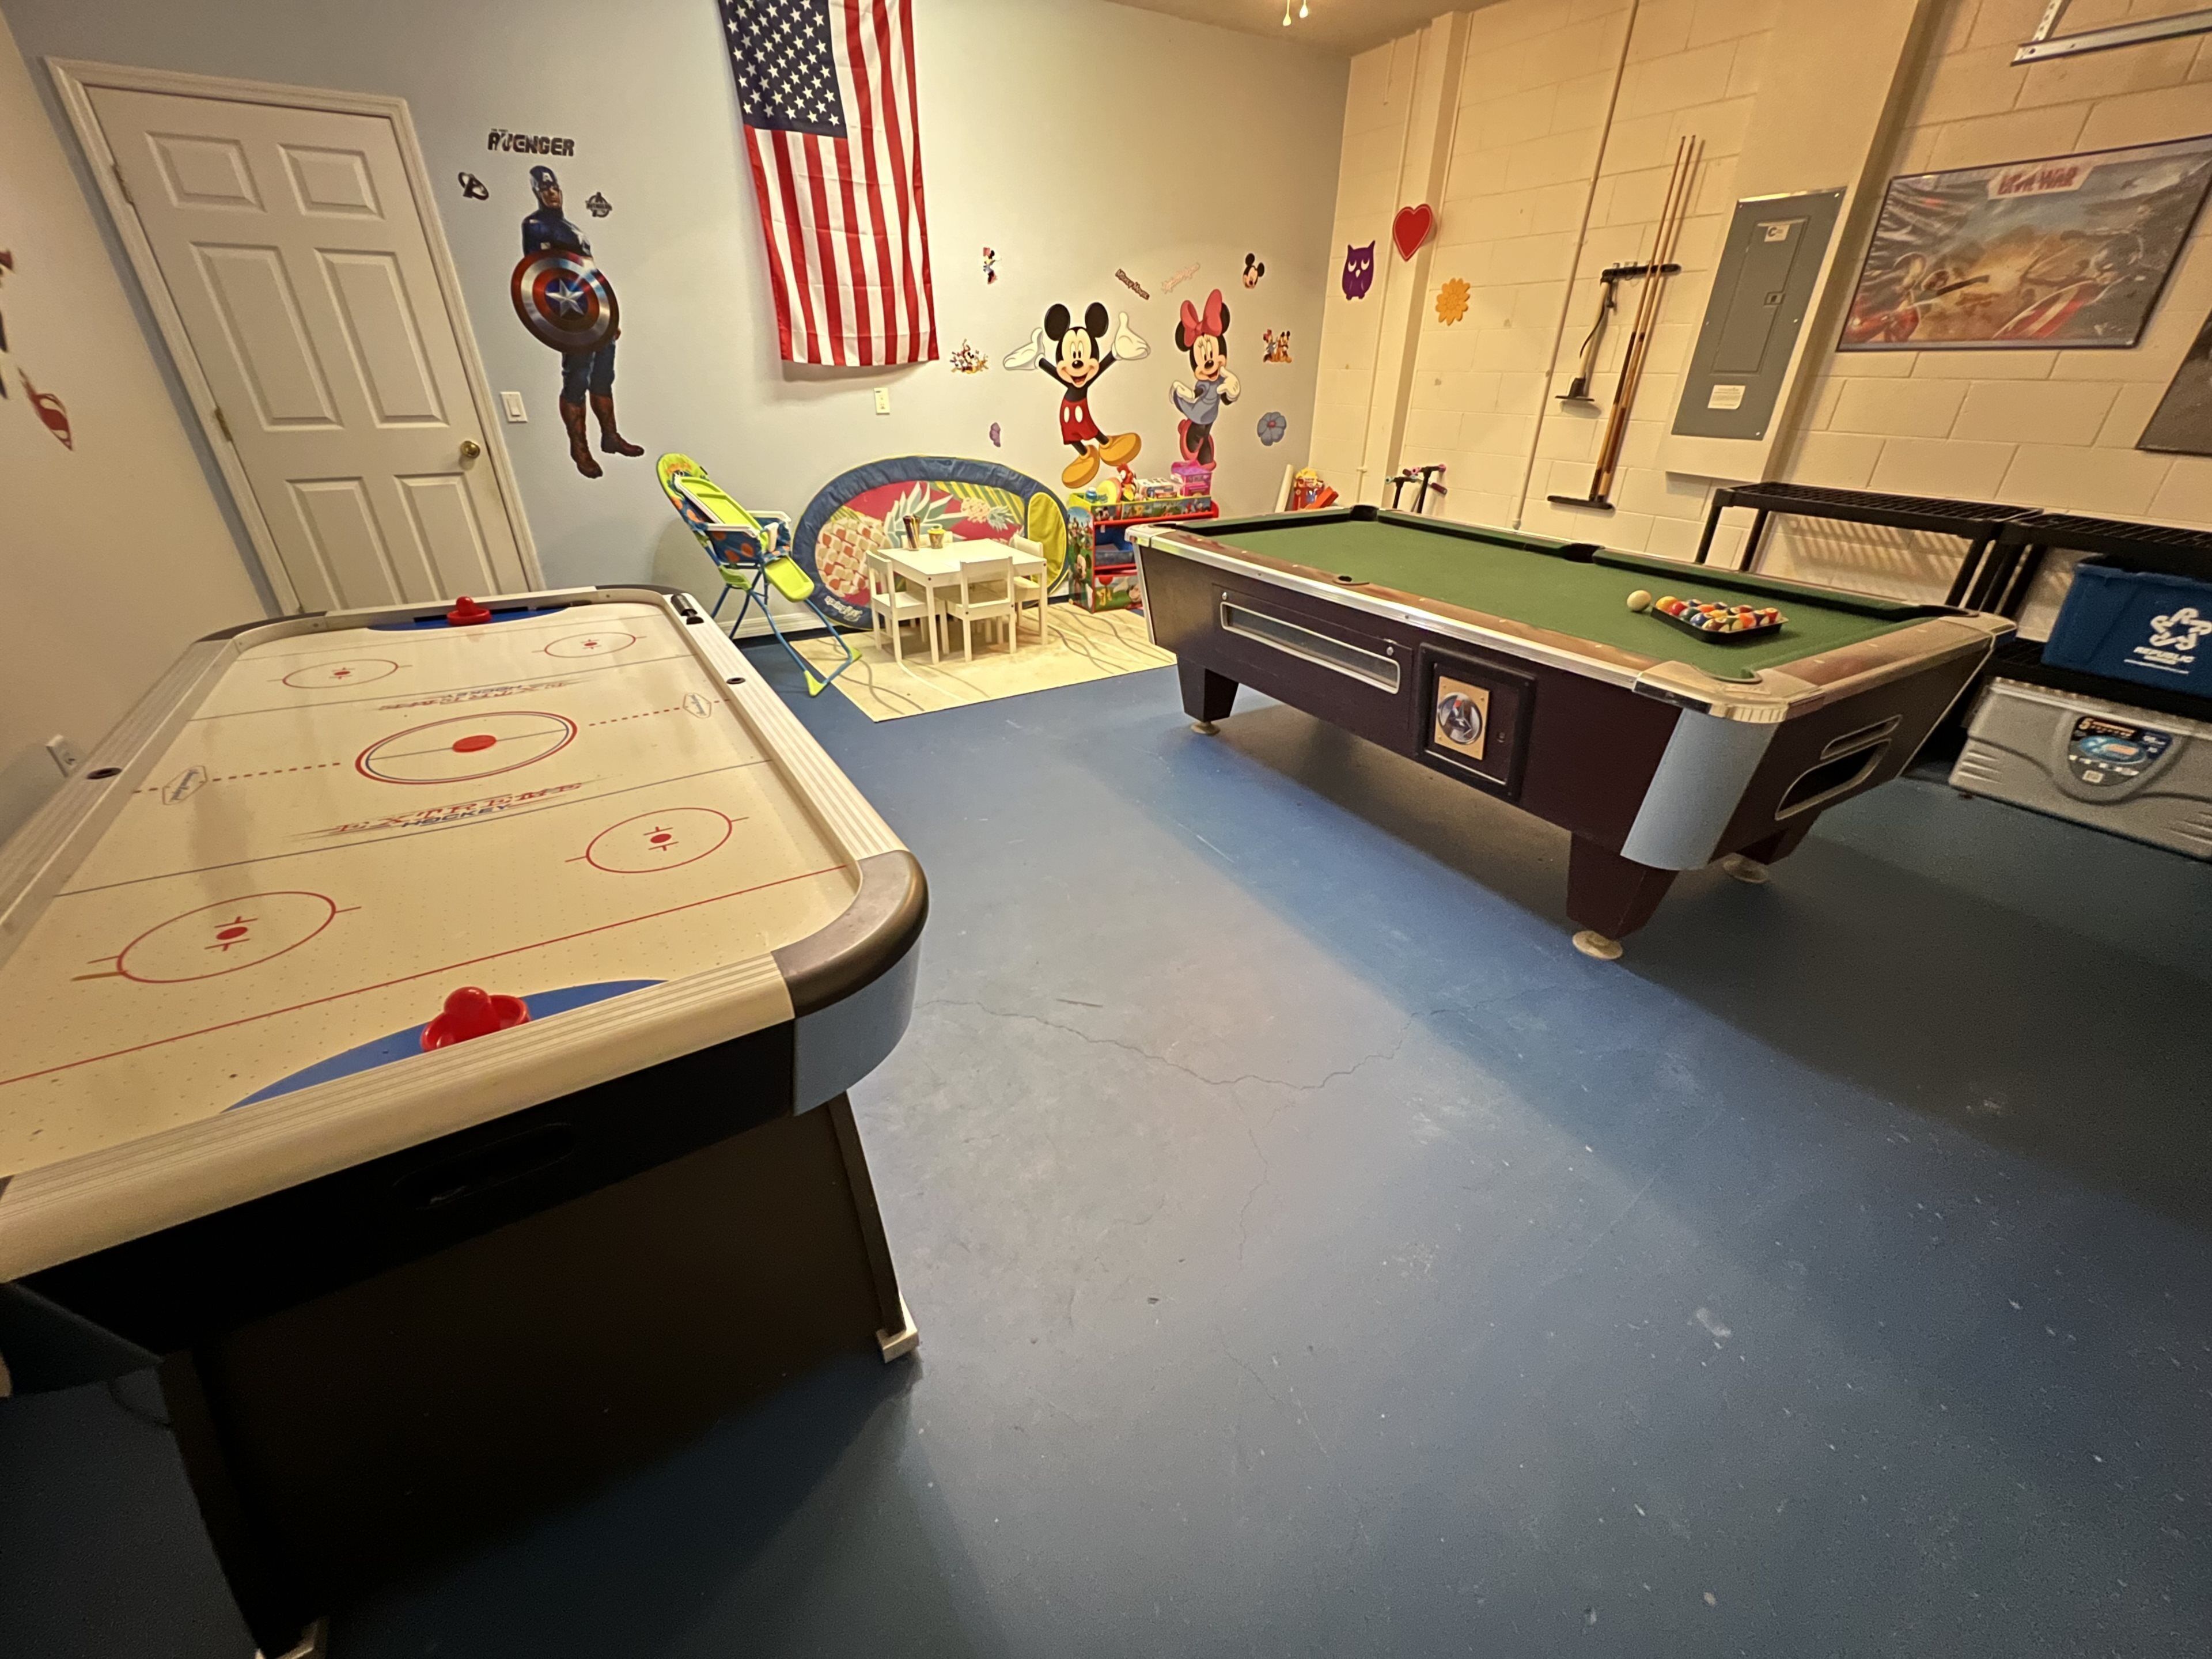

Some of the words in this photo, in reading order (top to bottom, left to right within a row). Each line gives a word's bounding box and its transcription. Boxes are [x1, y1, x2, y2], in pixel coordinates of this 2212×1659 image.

[488, 132, 574, 157] AVENGER
[336, 783, 582, 832] EXTREME
[402, 805, 507, 828] HOCKEY
